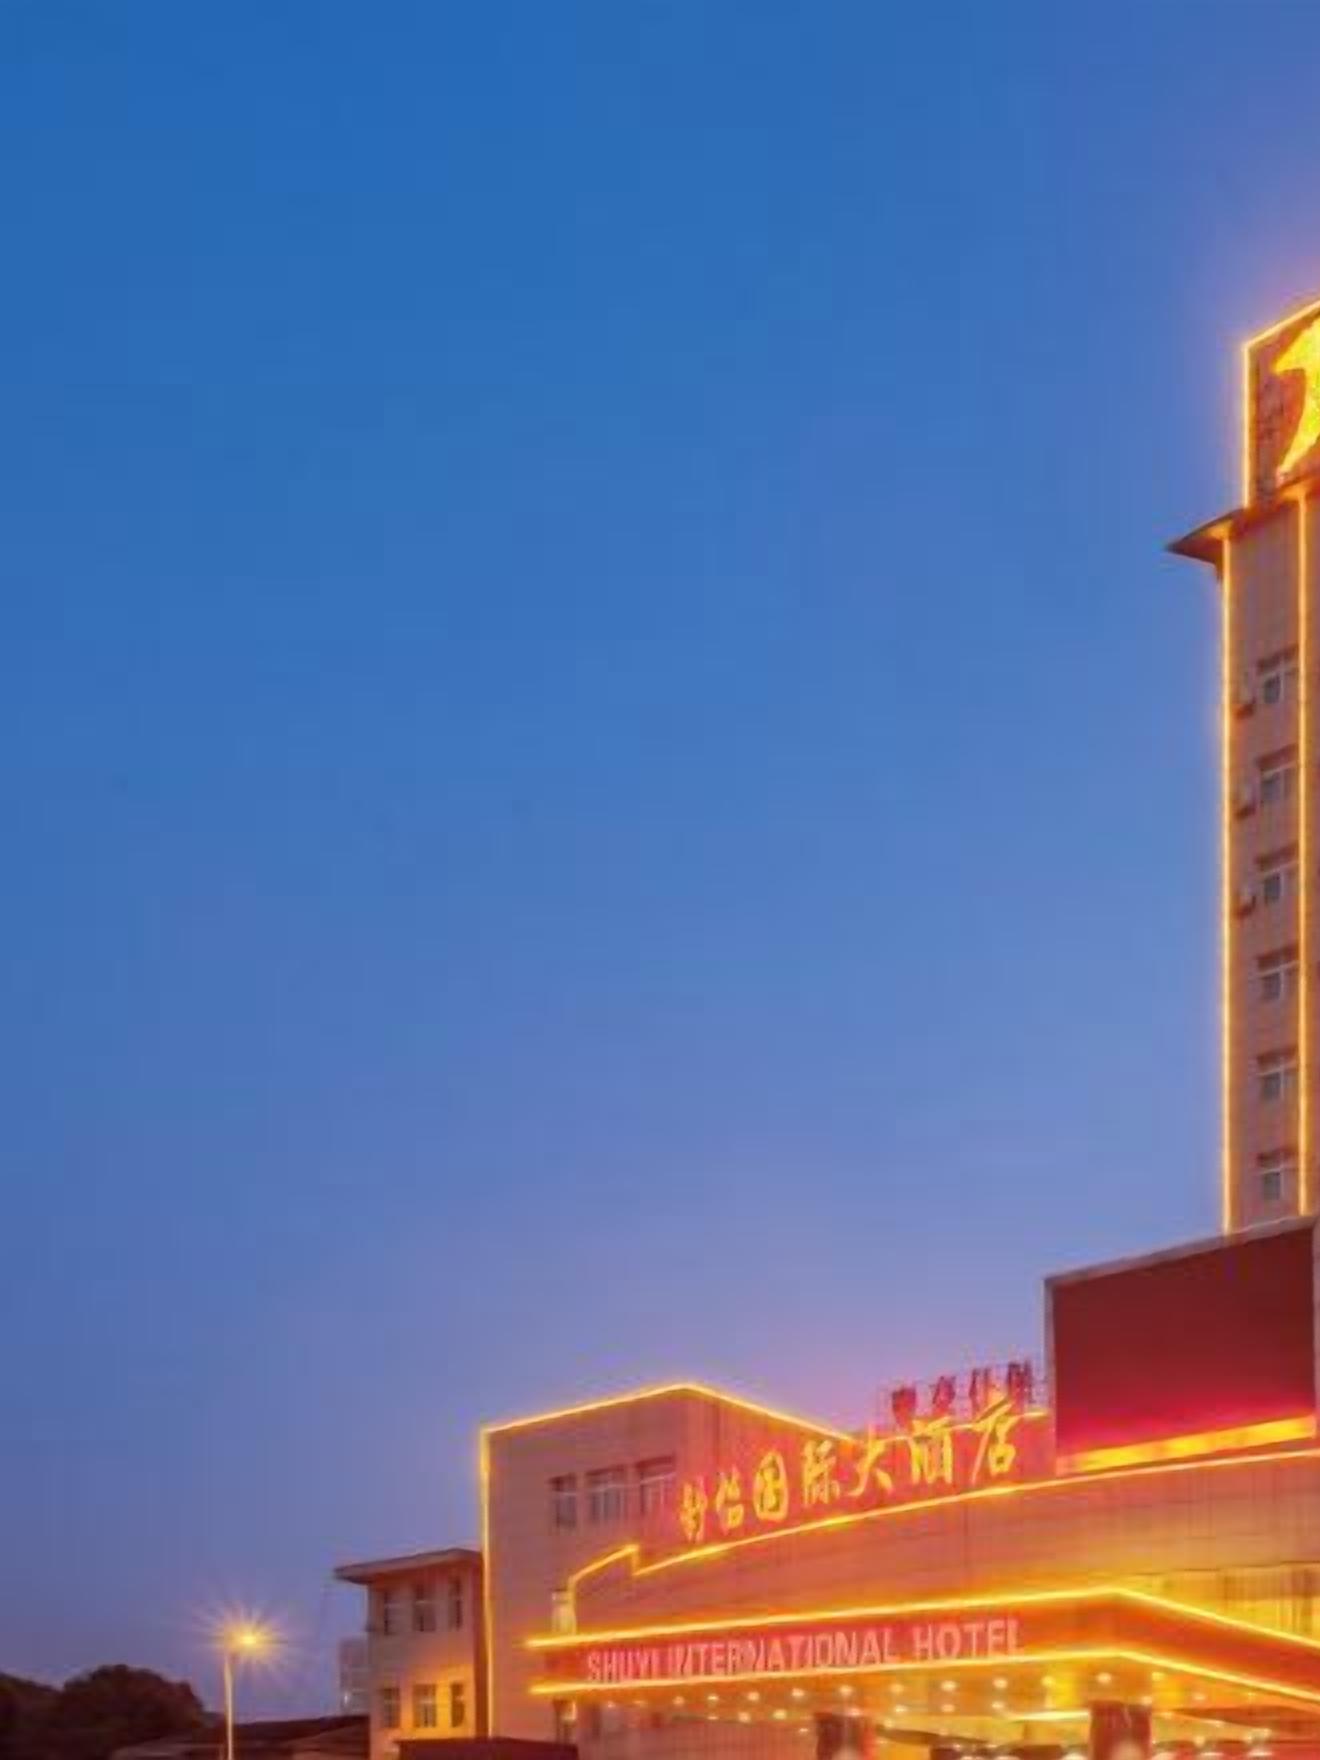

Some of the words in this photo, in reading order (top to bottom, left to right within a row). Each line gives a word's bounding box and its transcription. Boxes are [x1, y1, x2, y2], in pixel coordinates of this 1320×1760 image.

[679, 1394, 1024, 1542] 舒怡国际大酒店
[587, 1647, 661, 1684] SHUYI
[667, 1626, 899, 1678] INTERNATIONAL
[911, 1616, 1025, 1661] HOTEL
